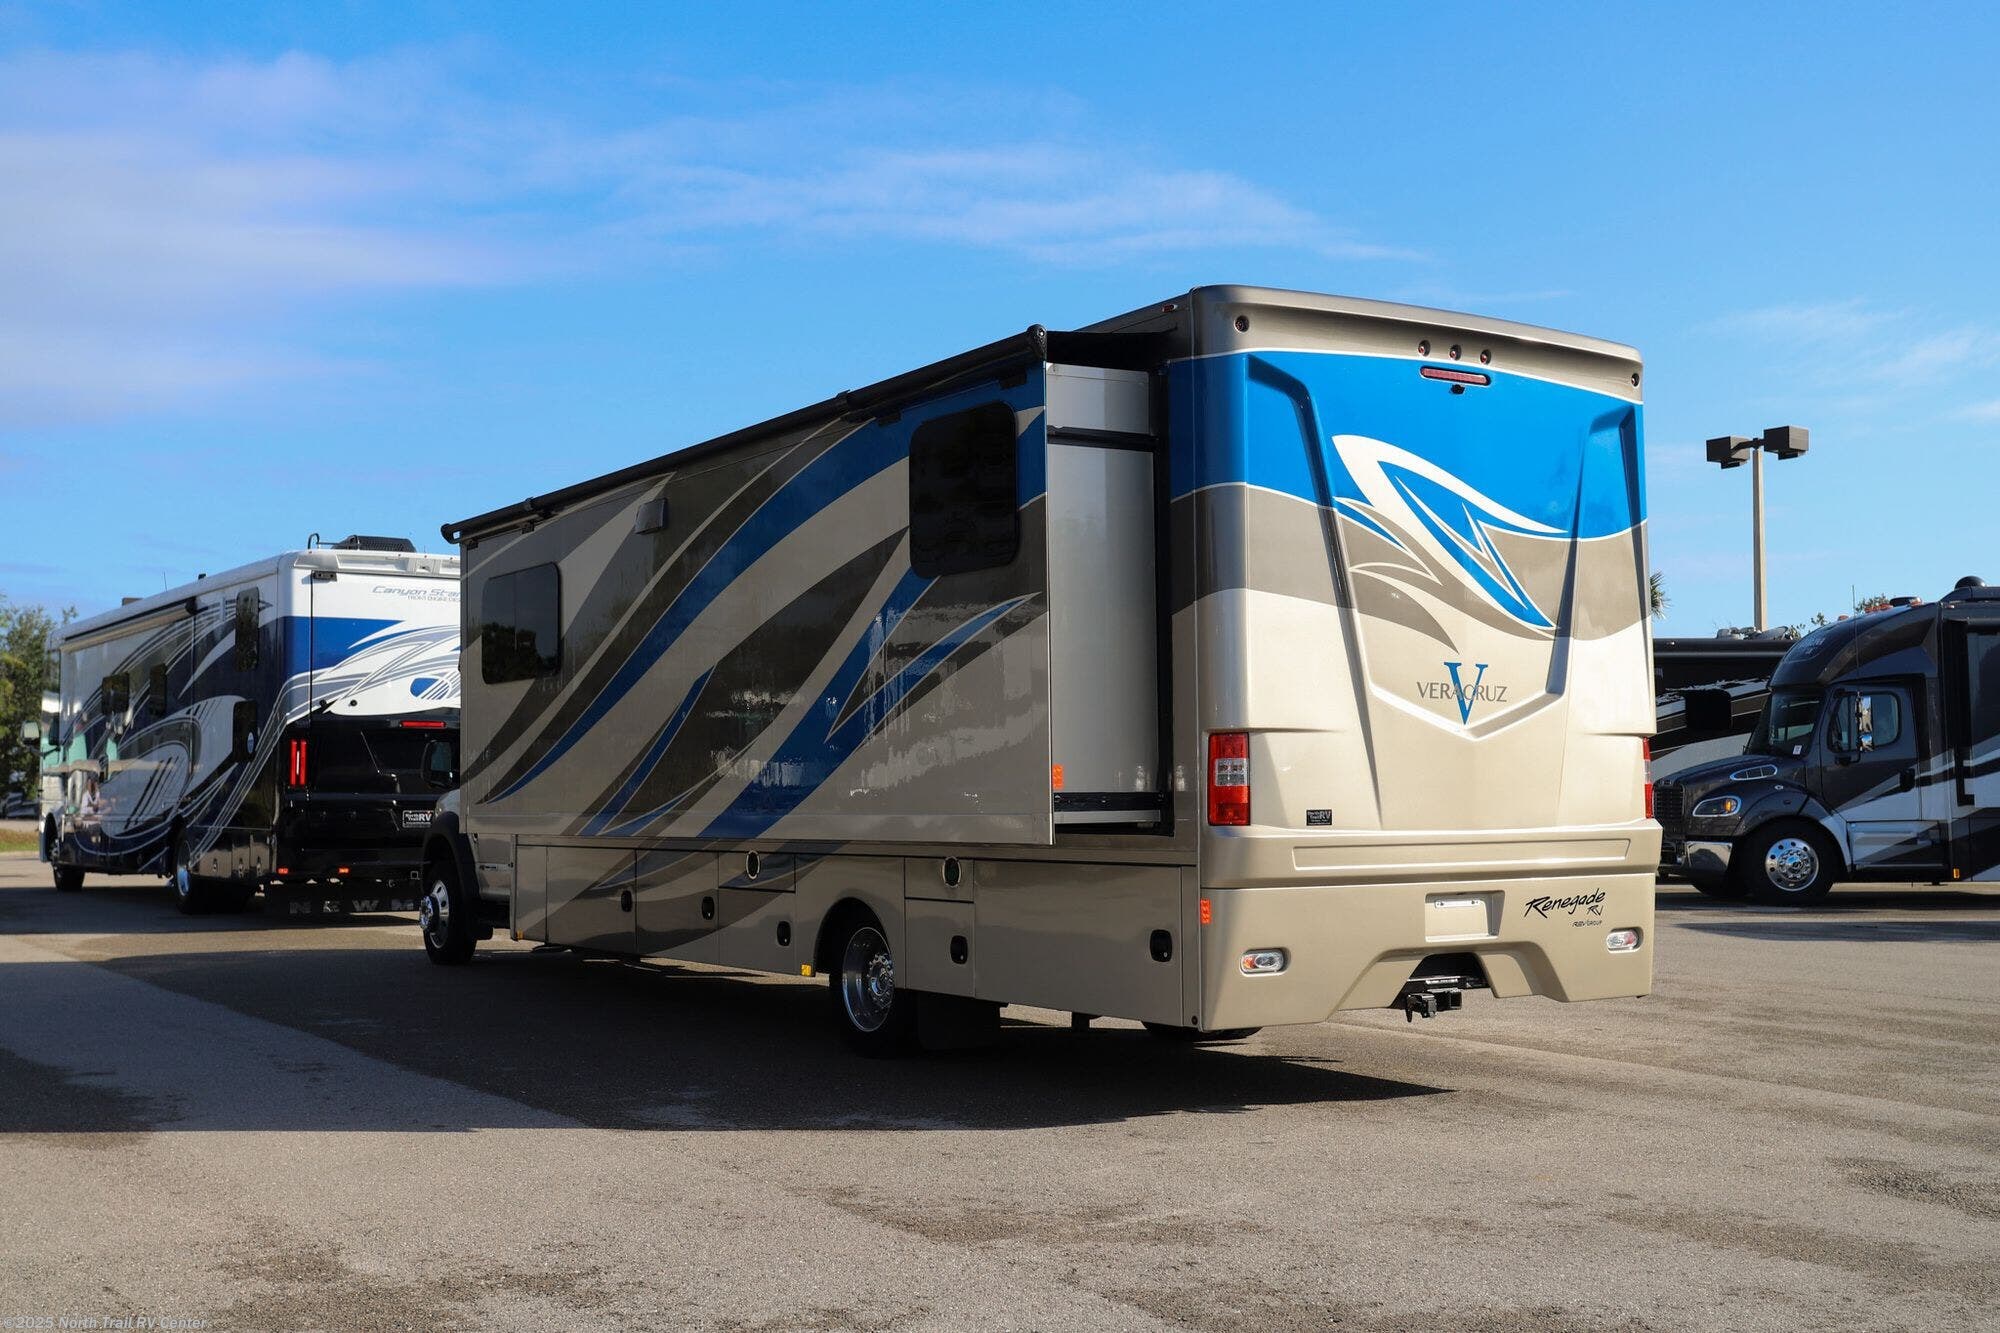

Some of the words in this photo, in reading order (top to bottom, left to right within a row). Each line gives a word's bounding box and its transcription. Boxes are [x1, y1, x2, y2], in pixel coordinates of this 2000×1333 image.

[372, 585, 427, 597] Canyon
[1416, 681, 1508, 703] VERACRUZ
[1523, 887, 1606, 919] Renegade
[1586, 904, 1604, 916] RV
